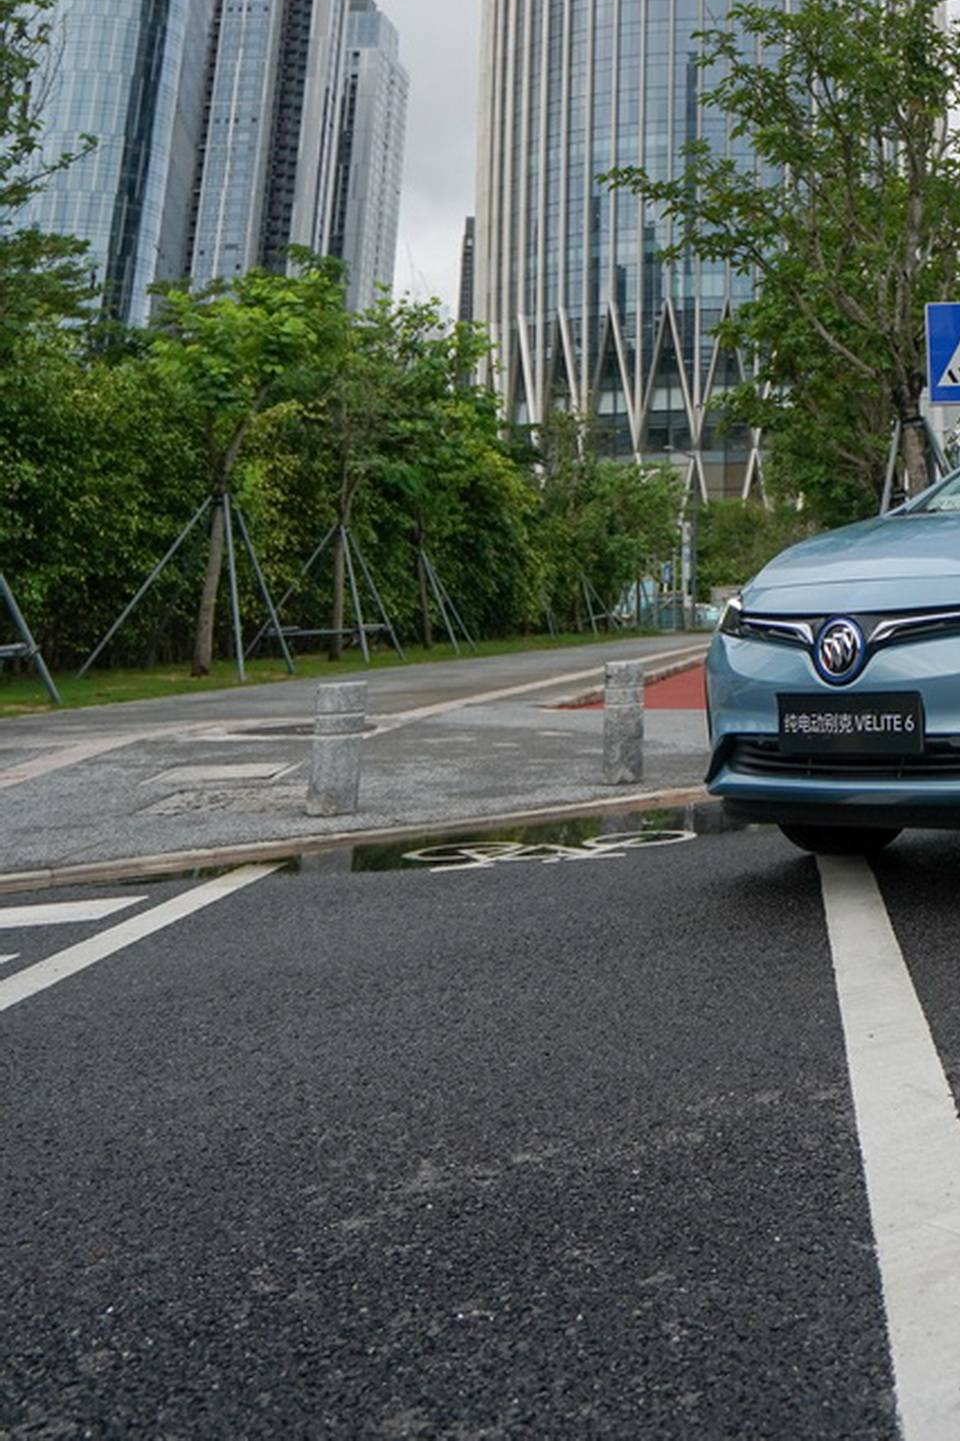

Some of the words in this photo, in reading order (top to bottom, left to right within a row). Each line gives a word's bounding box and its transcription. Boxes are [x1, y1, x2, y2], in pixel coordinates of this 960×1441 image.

[784, 713, 853, 734] 纯电动别克
[854, 714, 902, 732] VELITE
[904, 713, 915, 732] 6
